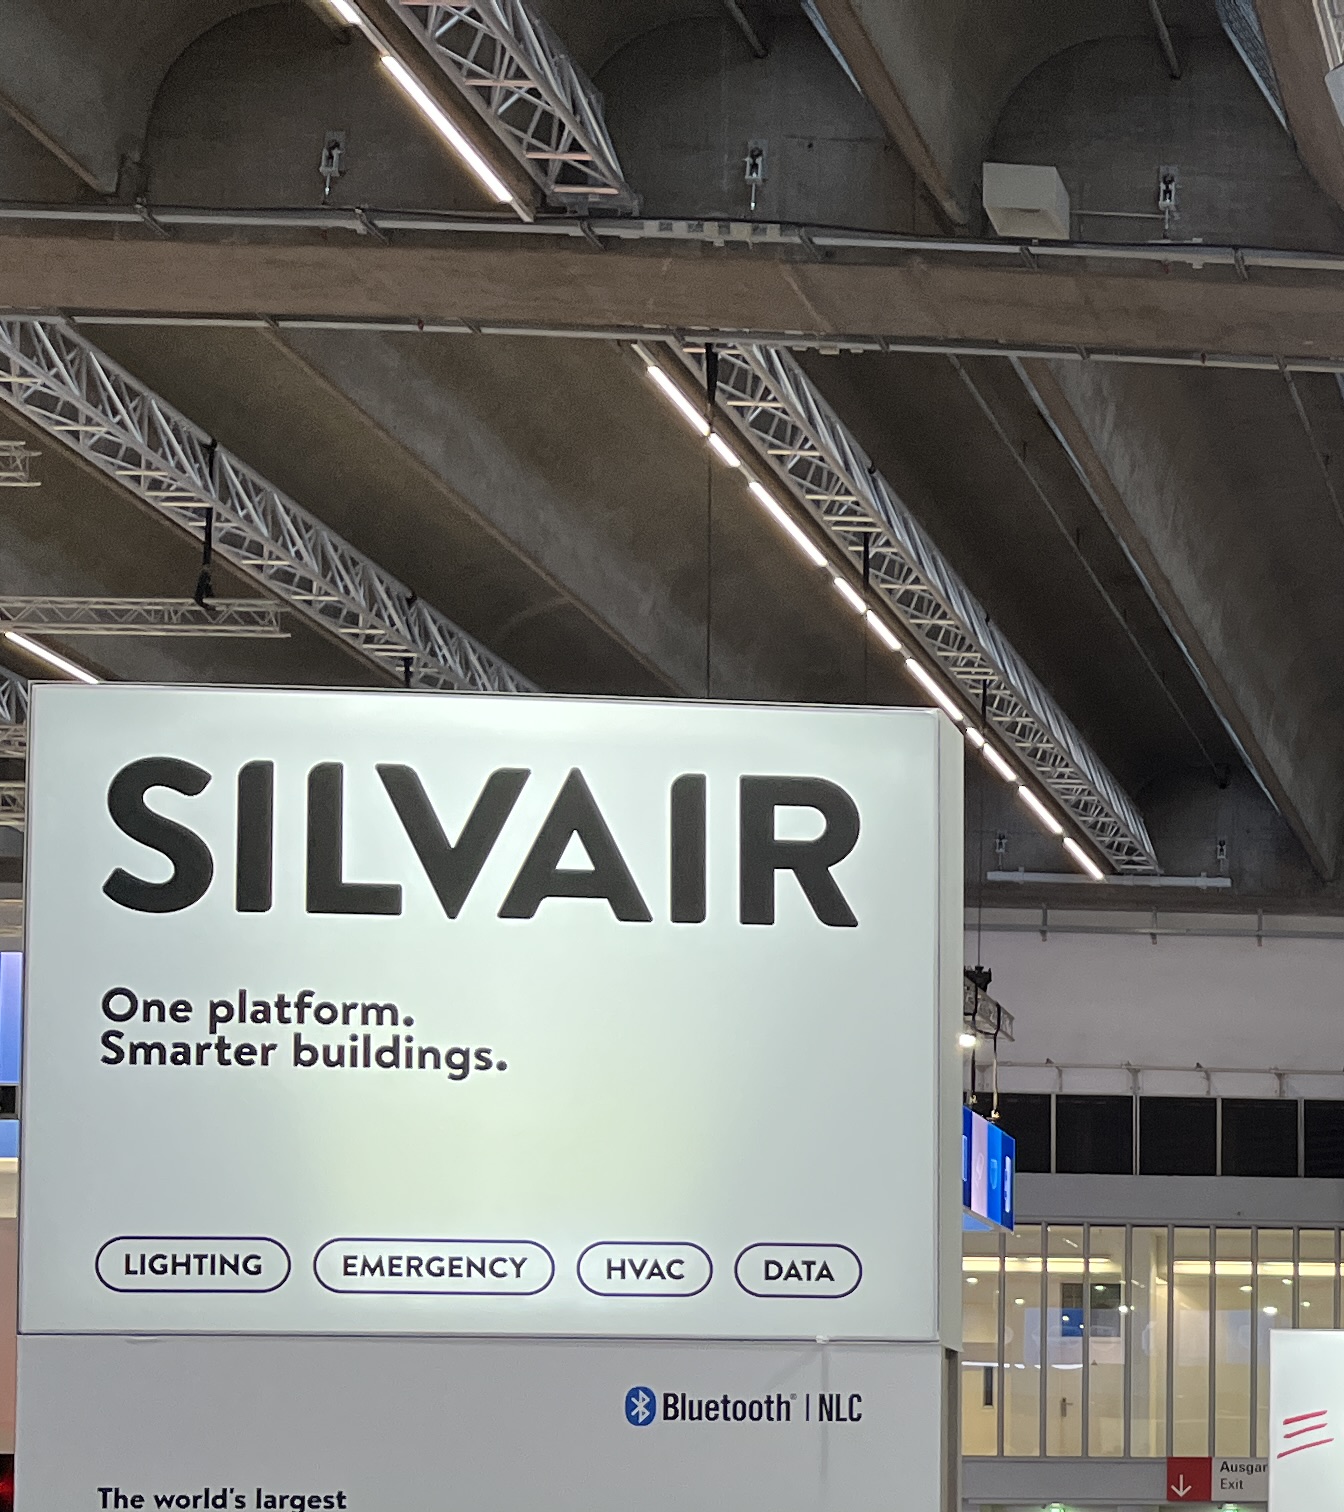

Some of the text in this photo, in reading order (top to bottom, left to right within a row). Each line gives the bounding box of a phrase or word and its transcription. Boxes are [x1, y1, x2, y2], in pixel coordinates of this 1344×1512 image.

[102, 757, 860, 927] SILVAIR
[102, 988, 414, 1035] One platform.
[101, 1031, 507, 1080] Smarter buildings.
[125, 1254, 835, 1281] LIGHTING EMERGENCY HVAC DATA
[819, 1394, 862, 1421] NLC
[1221, 1478, 1243, 1489] Exit
[98, 1488, 144, 1509] The
